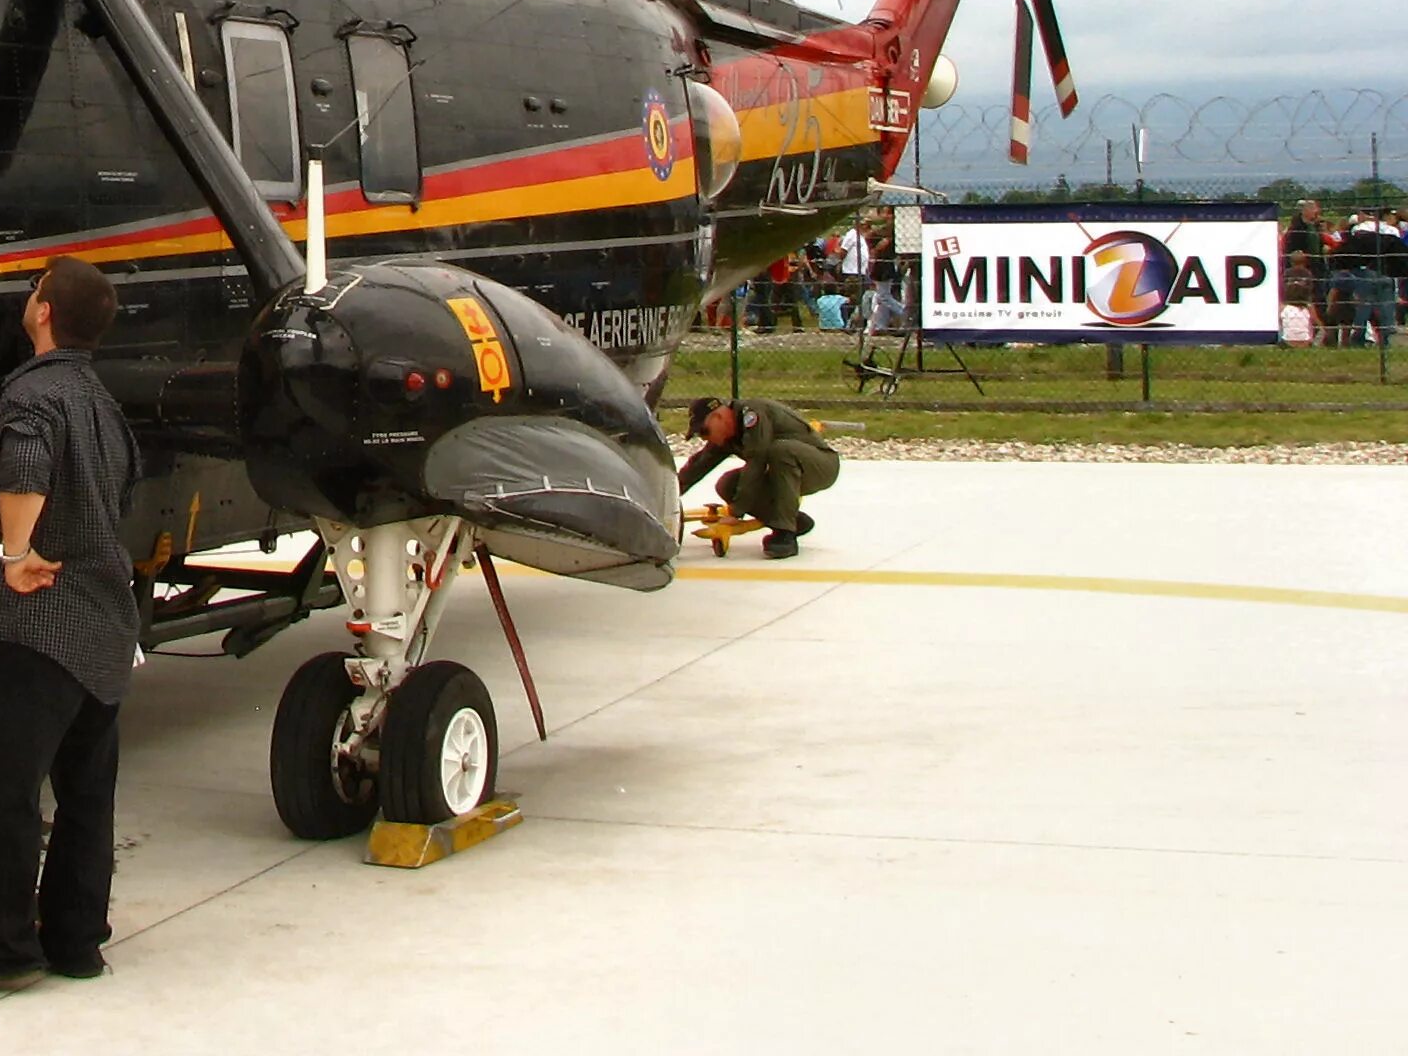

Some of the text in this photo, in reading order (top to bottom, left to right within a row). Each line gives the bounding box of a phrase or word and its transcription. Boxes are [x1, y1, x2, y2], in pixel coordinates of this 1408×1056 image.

[935, 237, 960, 257] LE
[933, 309, 1063, 320] Magazine TV gratuit
